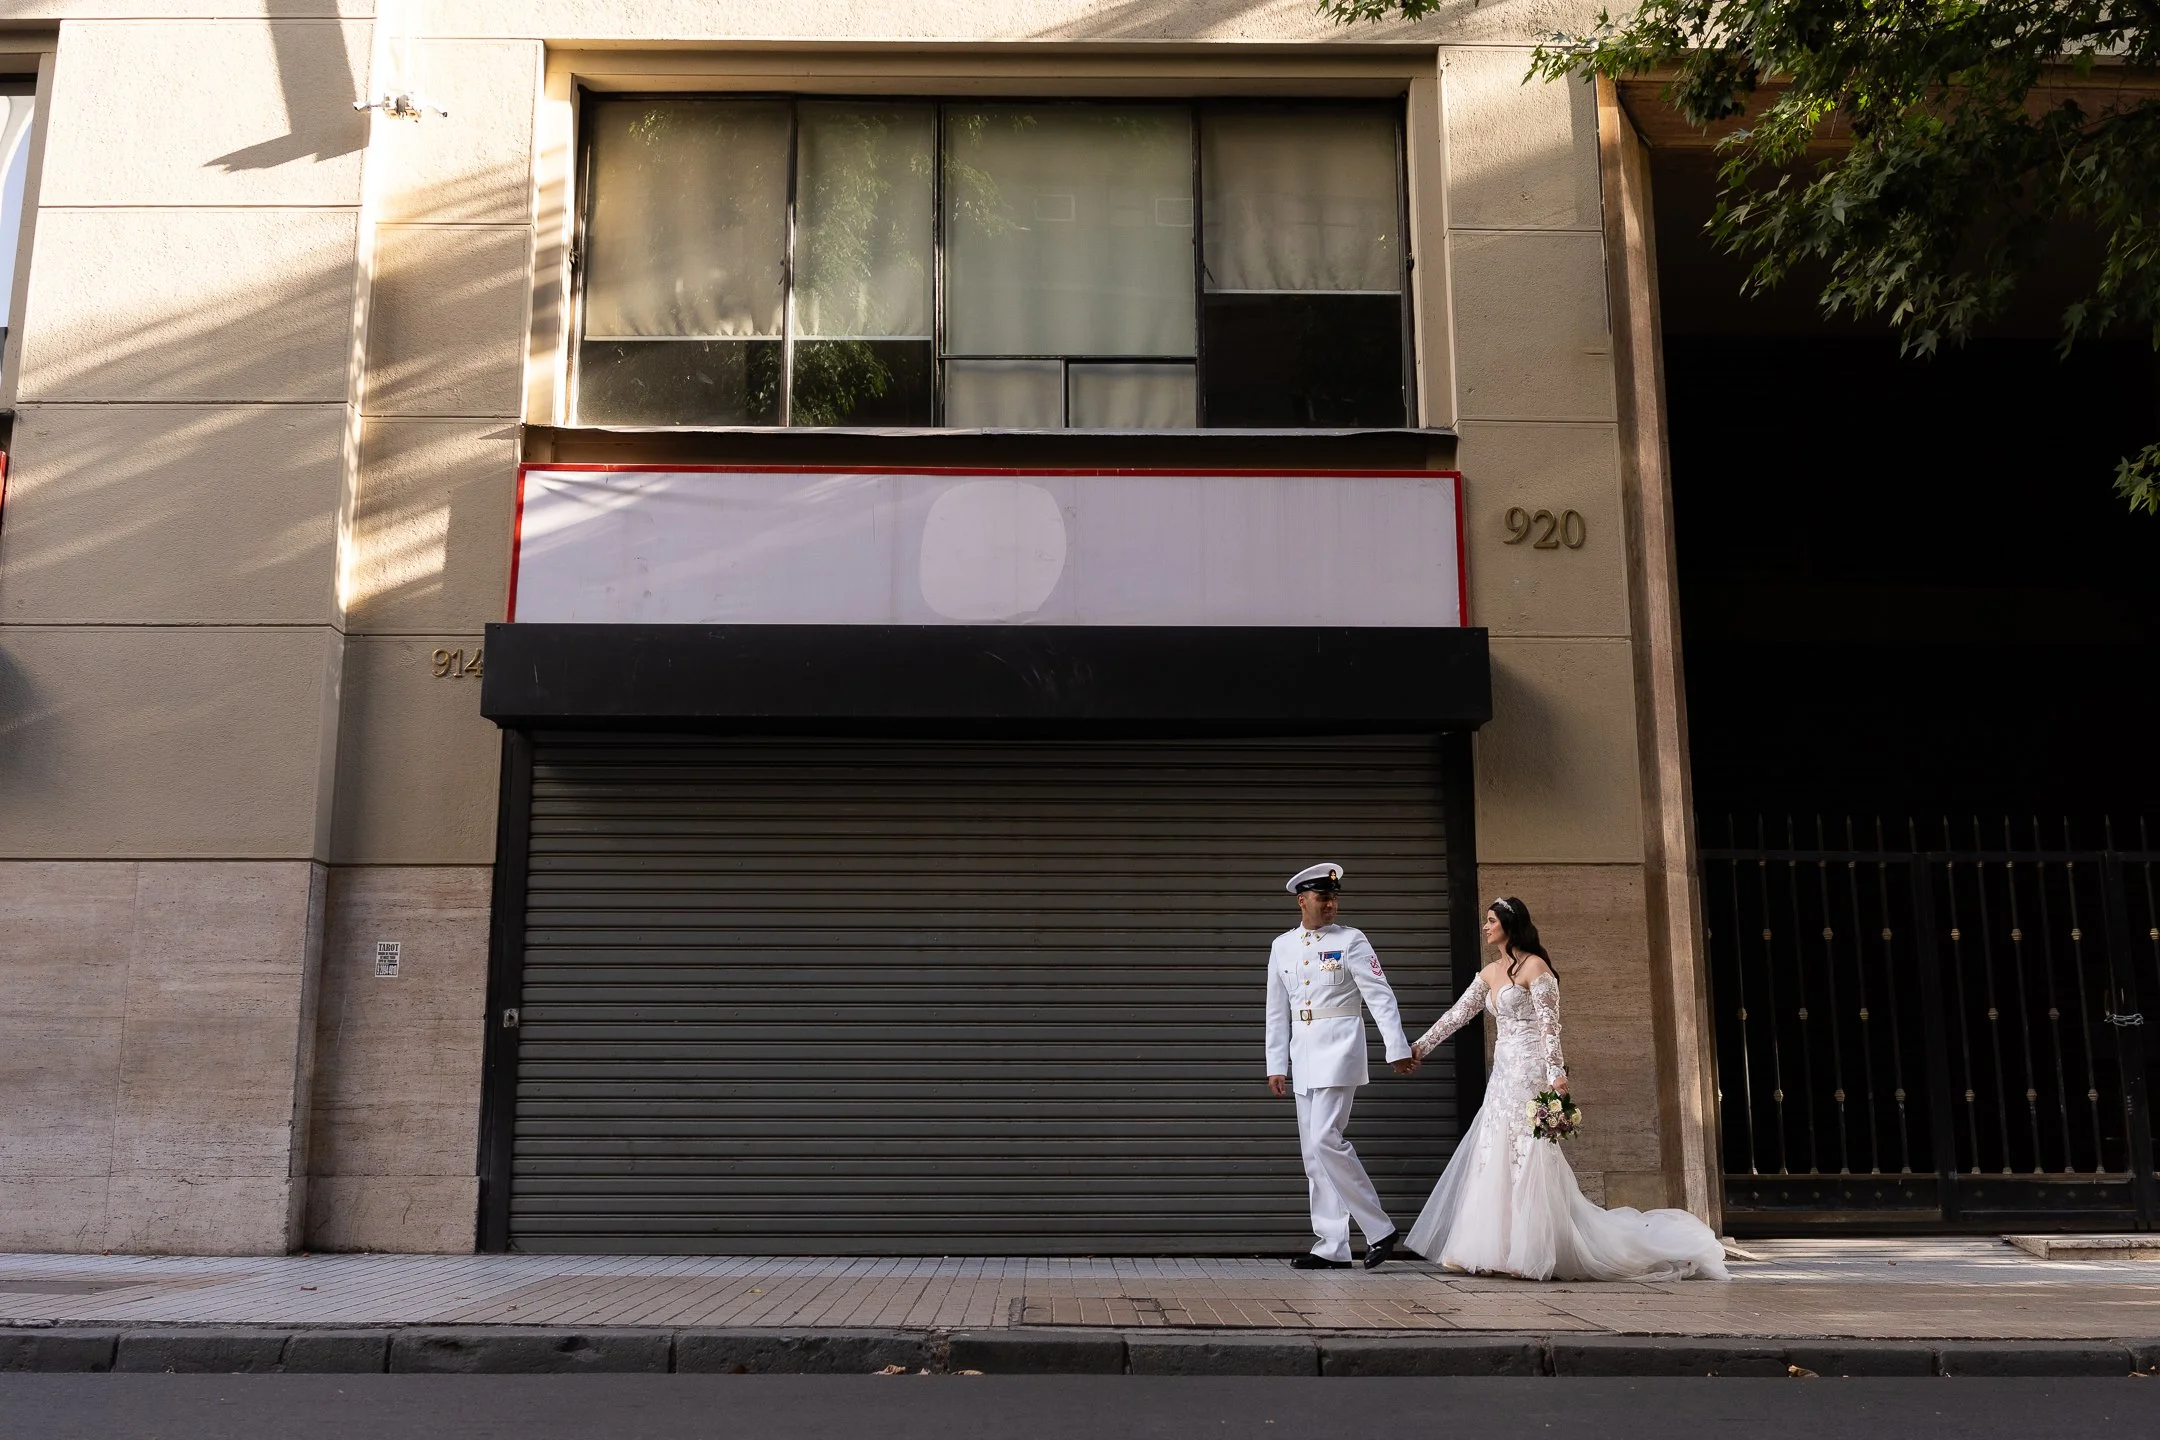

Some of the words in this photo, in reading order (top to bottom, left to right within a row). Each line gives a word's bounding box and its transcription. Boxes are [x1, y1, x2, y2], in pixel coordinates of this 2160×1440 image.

[1503, 507, 1585, 549] 920
[431, 648, 484, 678] 914
[379, 943, 399, 951] TAROT
